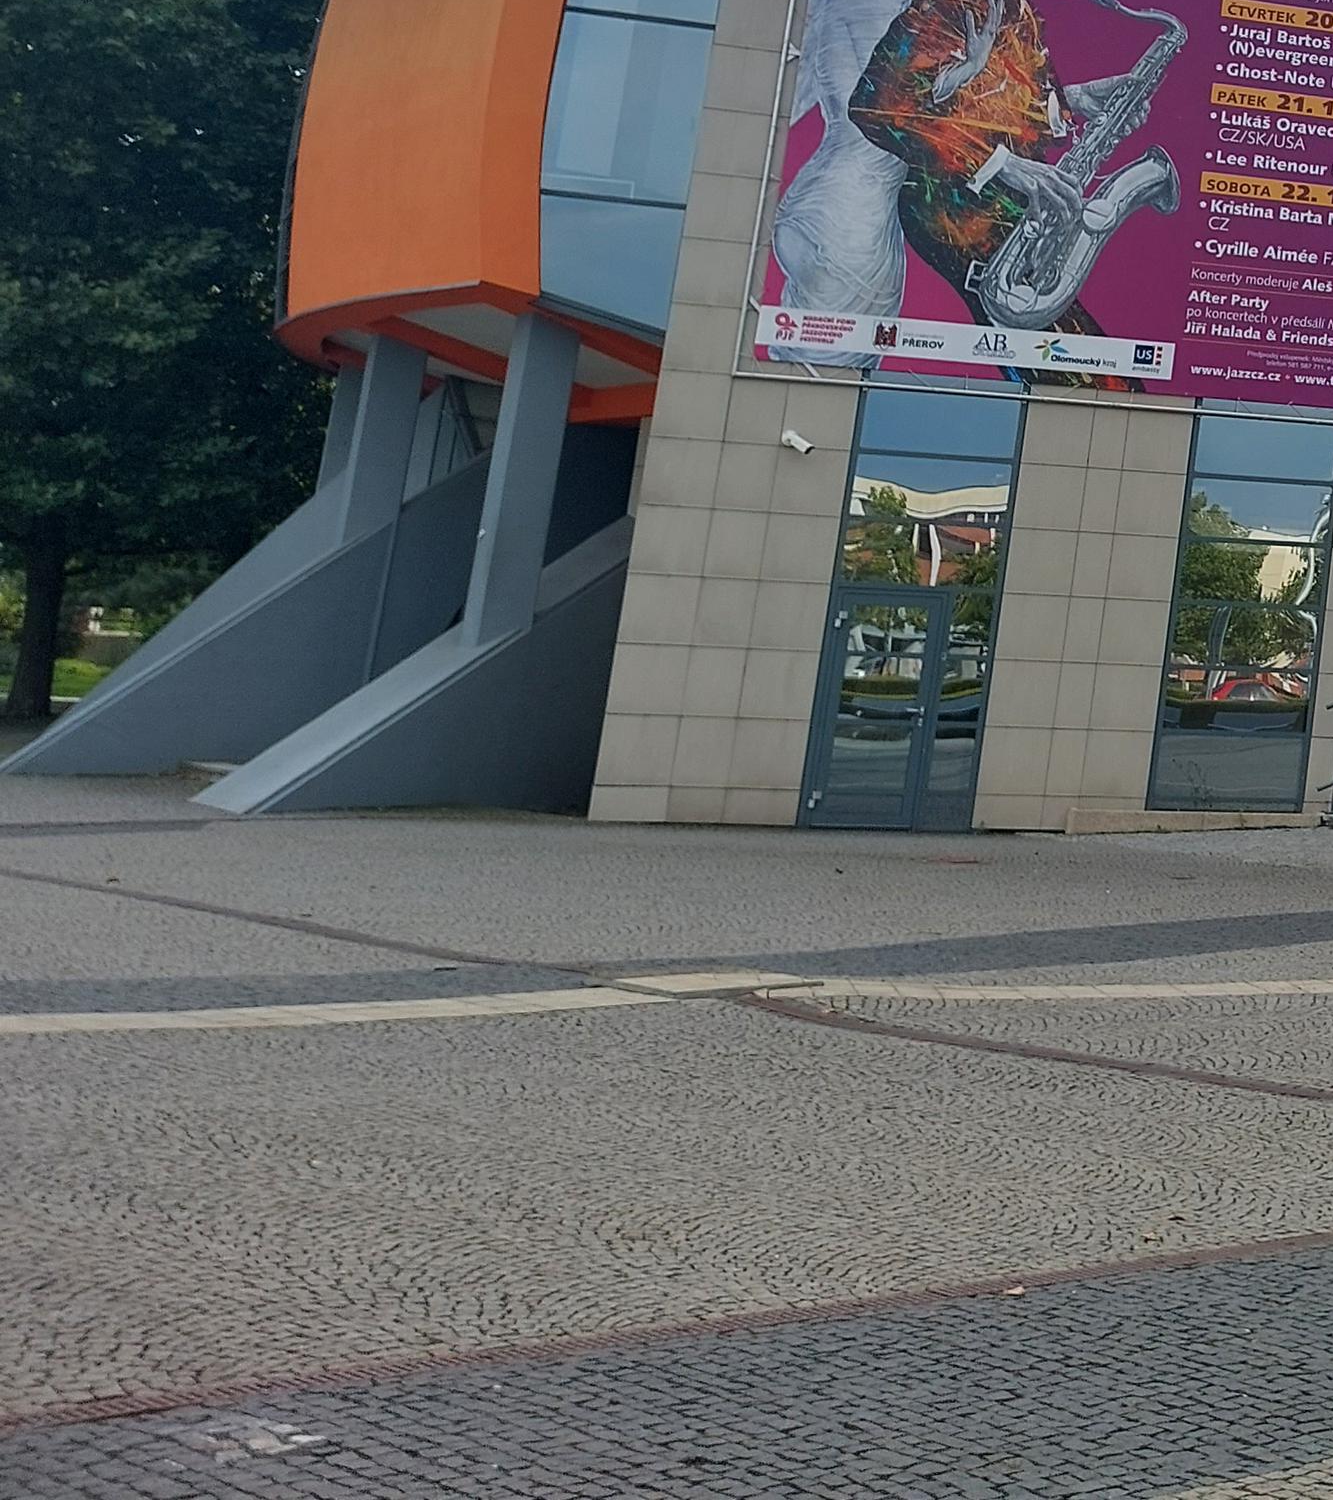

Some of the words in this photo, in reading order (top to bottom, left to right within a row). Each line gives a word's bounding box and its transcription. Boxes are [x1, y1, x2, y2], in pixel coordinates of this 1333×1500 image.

[1227, 2, 1295, 24] ČTVRTEK
[1230, 24, 1271, 45] Juraj
[1276, 31, 1331, 49] Bartoš
[1226, 62, 1325, 88] Ghost-Note
[1217, 90, 1267, 108] PÁTEK
[1277, 94, 1312, 113] 21.
[1221, 110, 1271, 129] Lukáš
[1219, 128, 1306, 151] CZ/SK/USA
[1216, 151, 1247, 166] Lee
[1253, 154, 1328, 175] Ritenour
[1206, 179, 1271, 197] SOBOTA
[1281, 183, 1317, 202] 22.
[1210, 199, 1274, 219] Kristina
[1279, 206, 1322, 225] Barta
[1208, 217, 1230, 231] CZ
[1205, 239, 1258, 259] Cyrille
[1264, 245, 1318, 264] Aimée
[1191, 268, 1242, 286] Koncerty
[1245, 275, 1298, 290] moderuje
[1302, 278, 1333, 293] Aleš
[1188, 290, 1227, 305] After
[1231, 294, 1269, 312] Party
[1186, 307, 1202, 319] po
[1205, 308, 1267, 325] koncertech
[1271, 316, 1278, 325] v
[1281, 315, 1325, 330] předsálí
[902, 337, 944, 349] PŘEROV
[974, 332, 1008, 352] AB
[1184, 323, 1206, 335] Jiří
[1212, 325, 1260, 340] Halada
[1266, 330, 1277, 341] &
[1051, 354, 1101, 367] Olomoucký
[1103, 358, 1117, 369] kraj
[1136, 349, 1152, 360] US
[1191, 365, 1281, 381] www.jazzcz.cz
